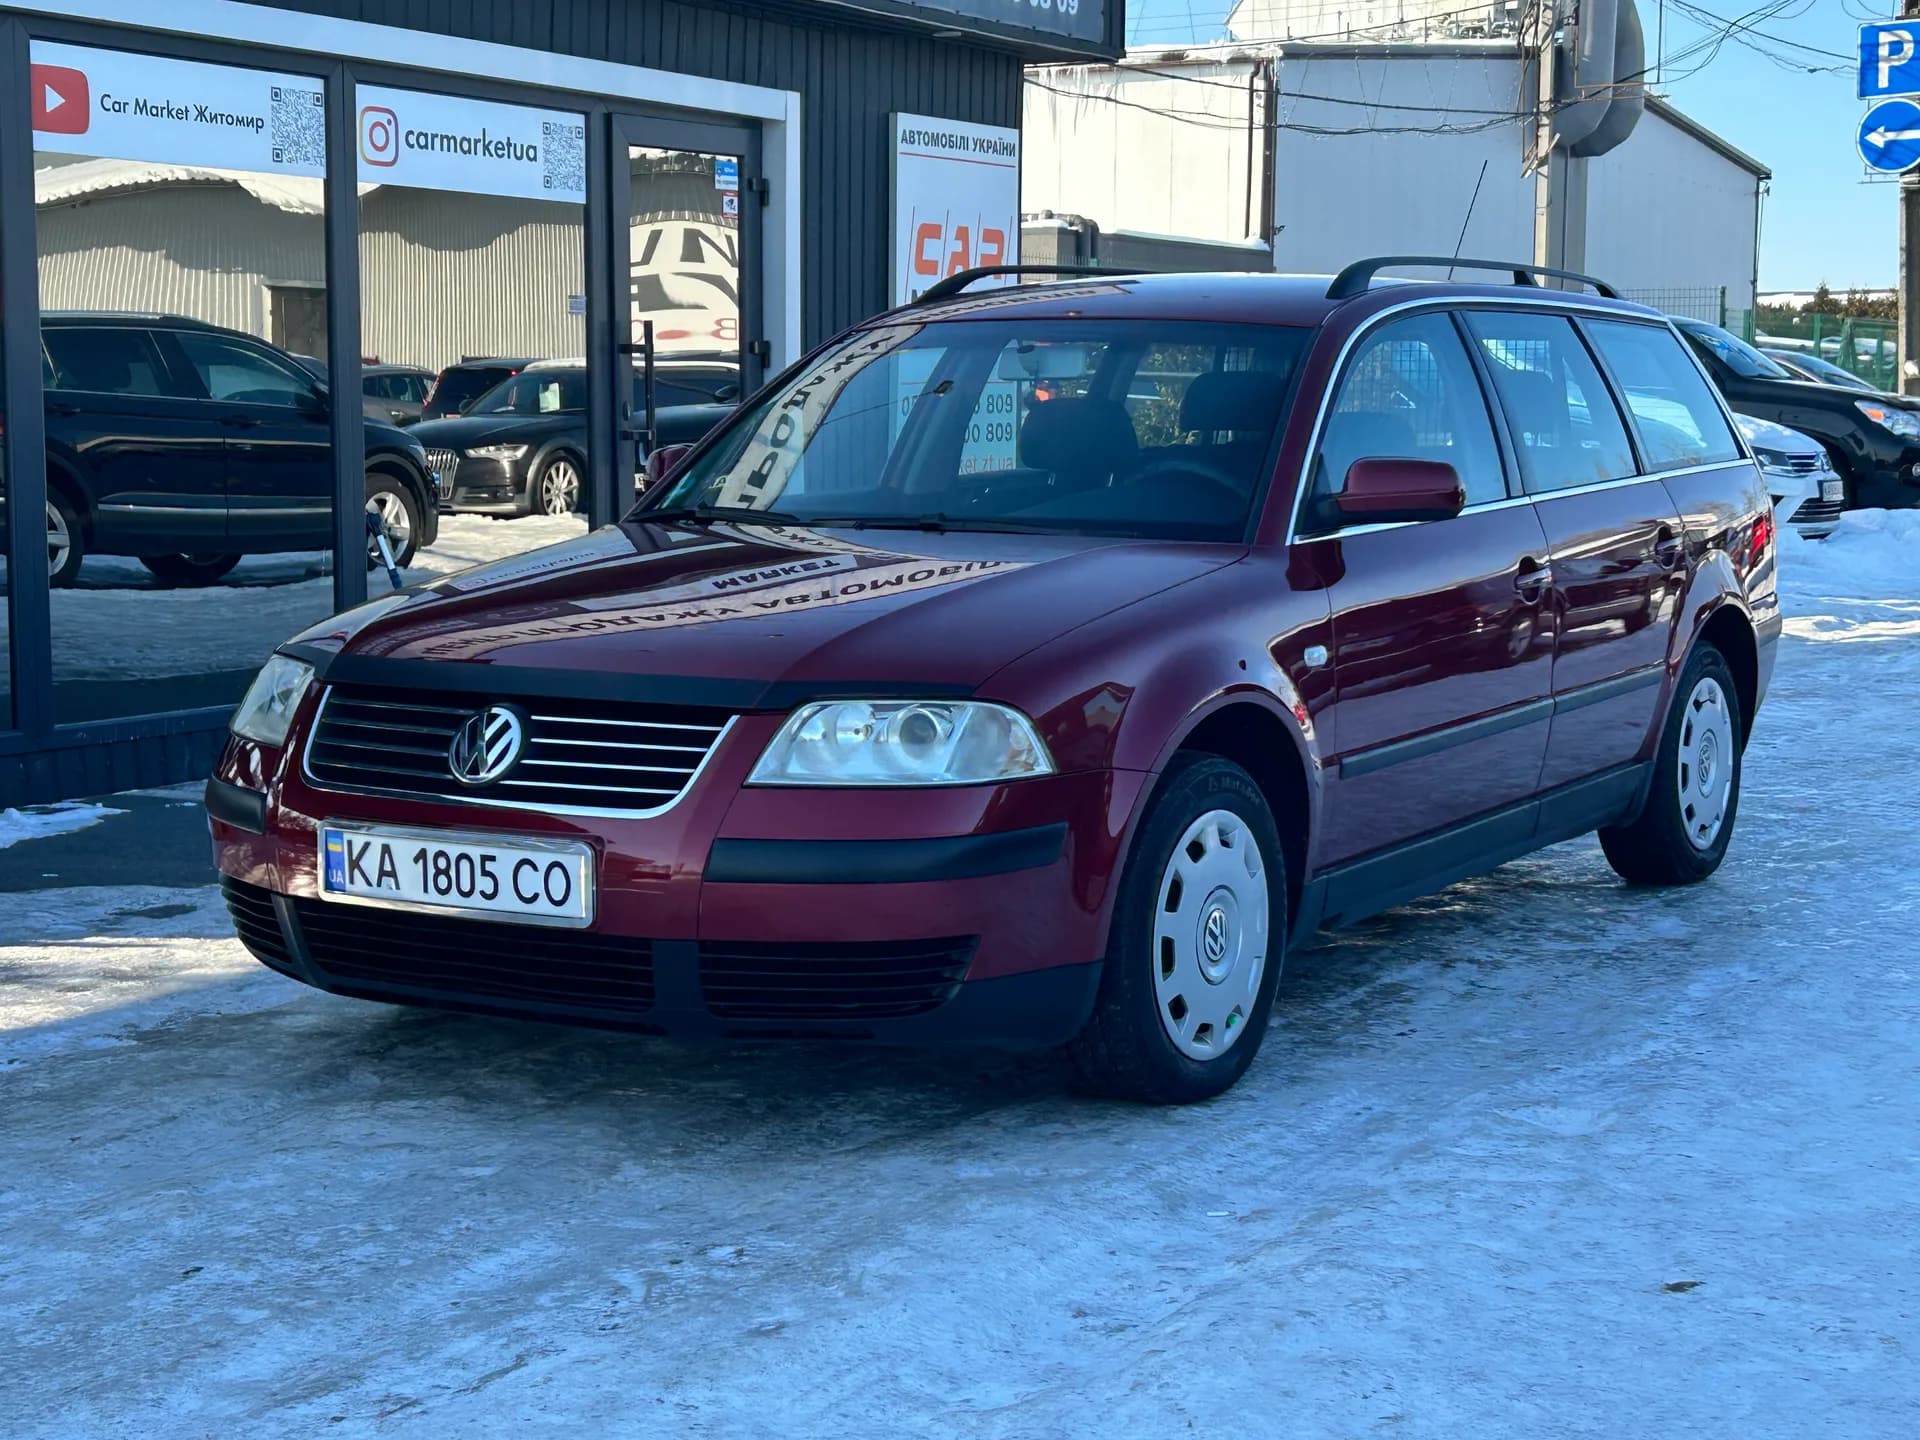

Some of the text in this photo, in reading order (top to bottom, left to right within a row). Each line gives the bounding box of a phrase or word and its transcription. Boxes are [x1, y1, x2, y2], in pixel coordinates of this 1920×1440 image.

[1878, 30, 1914, 89] P
[100, 93, 265, 134] Car Market Житомир
[404, 127, 538, 162] carmarketua
[900, 129, 1017, 158] АВТОМОБІЛІ УКРАЇНИ
[986, 394, 1013, 414] 809
[985, 422, 1013, 442] 809
[329, 870, 345, 884] UA
[346, 839, 572, 907] KA 1805 CO
